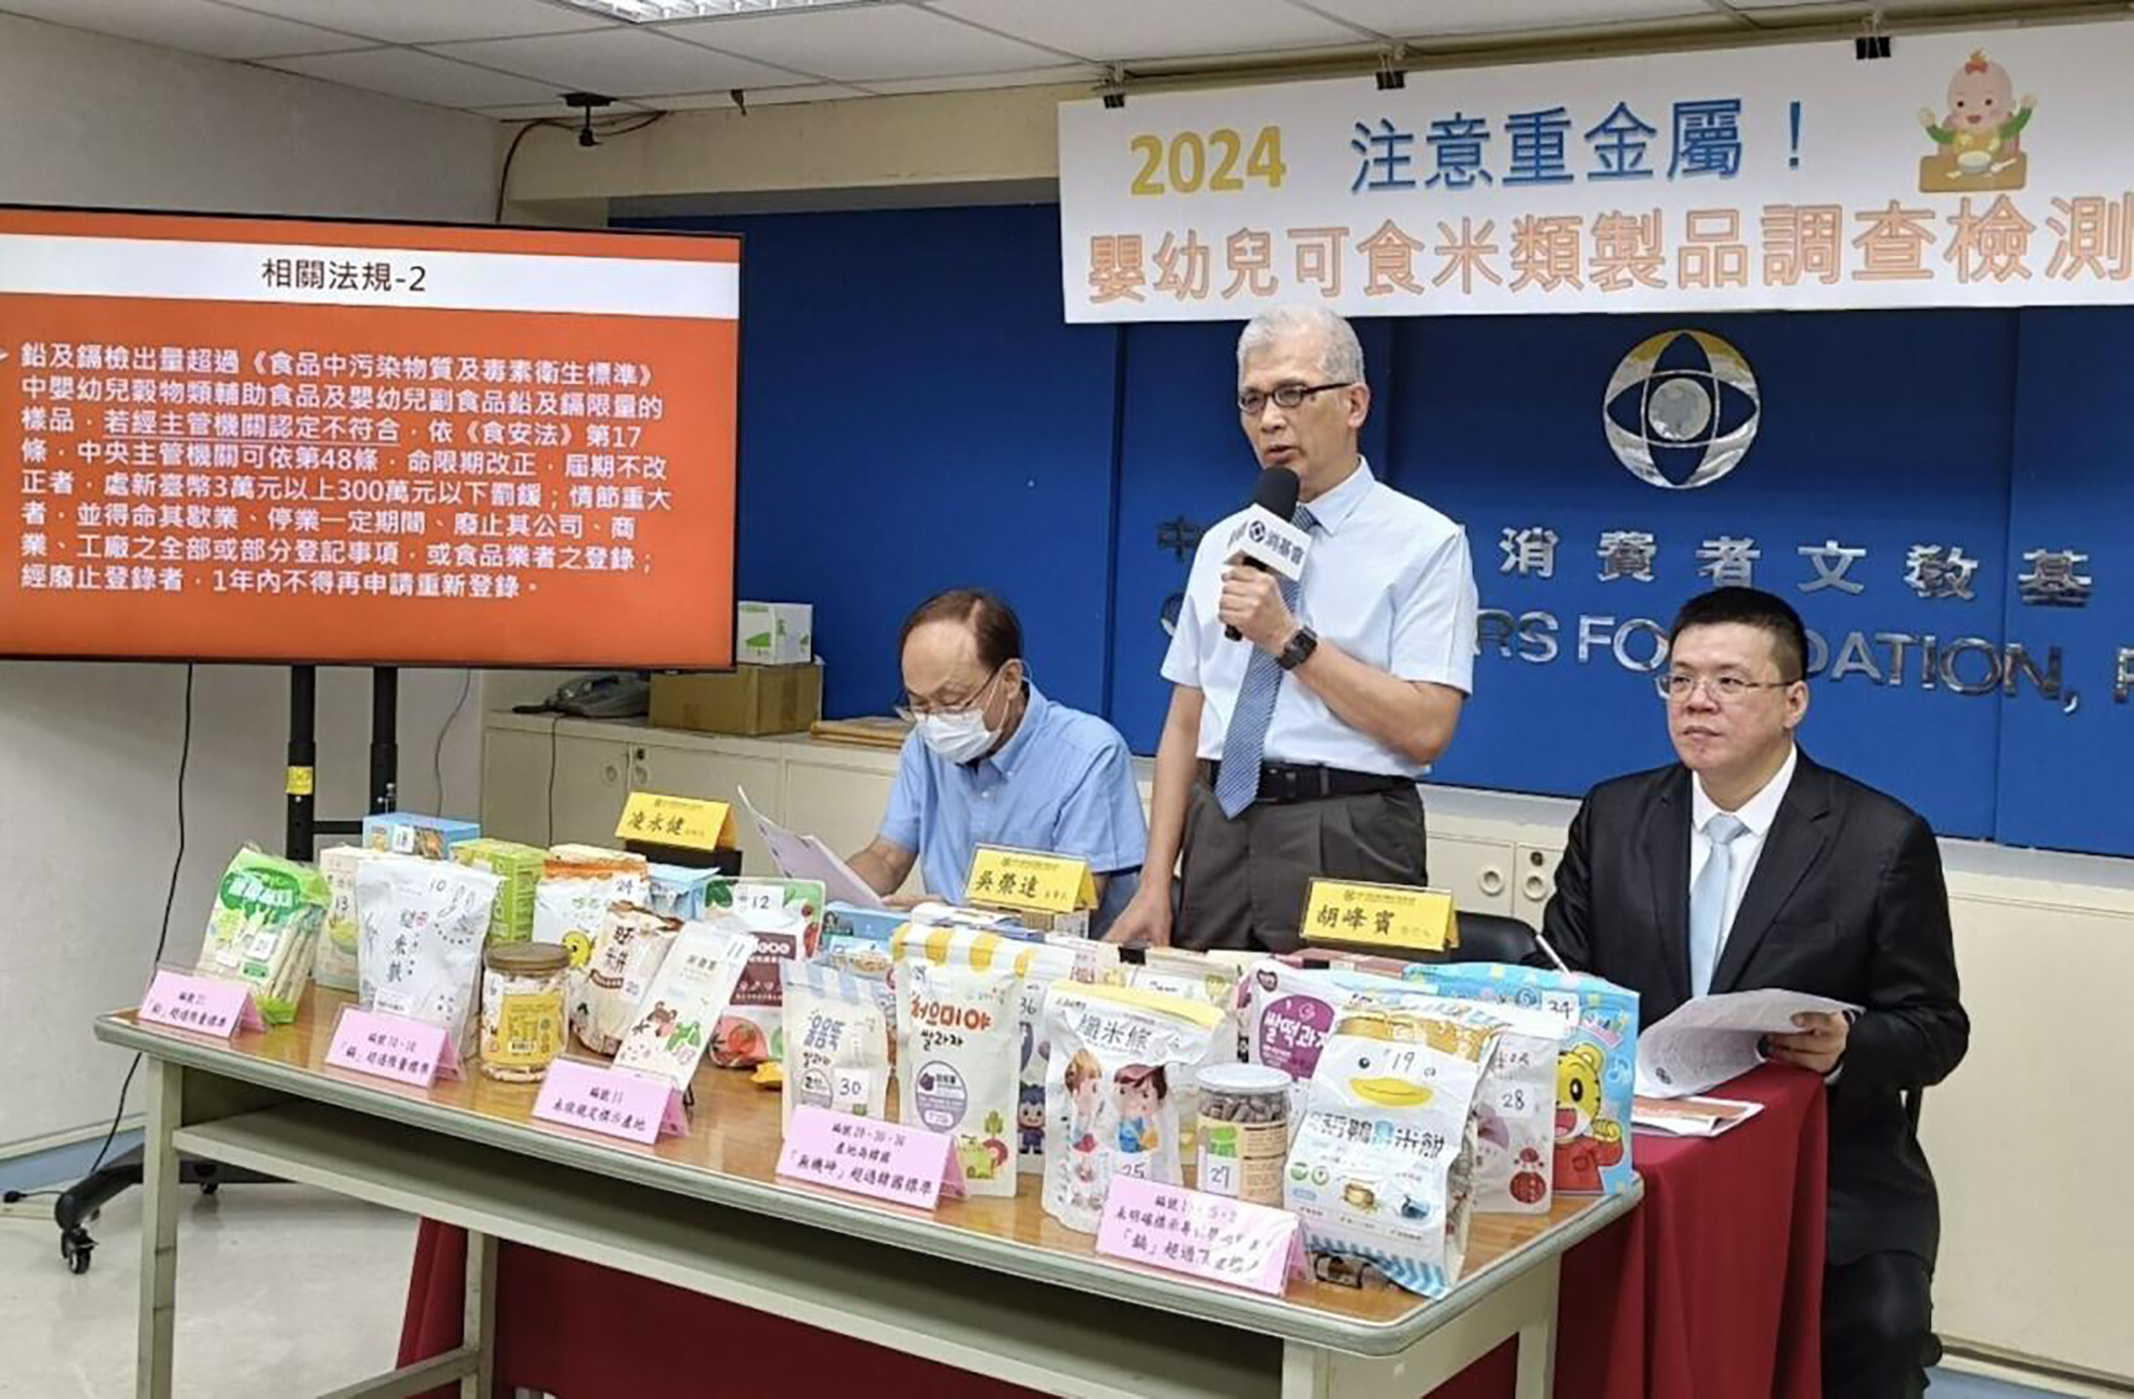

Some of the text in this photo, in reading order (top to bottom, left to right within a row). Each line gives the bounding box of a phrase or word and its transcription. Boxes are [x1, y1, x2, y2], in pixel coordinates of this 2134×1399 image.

[1128, 124, 1288, 197] 2024
[1087, 191, 2134, 302] 嬰幼兒可食米類製品調查檢測
[262, 257, 428, 293] 相關法規-2
[1393, 1052, 1415, 1073] 19
[840, 1078, 862, 1096] 30
[1502, 1089, 1525, 1111] 28
